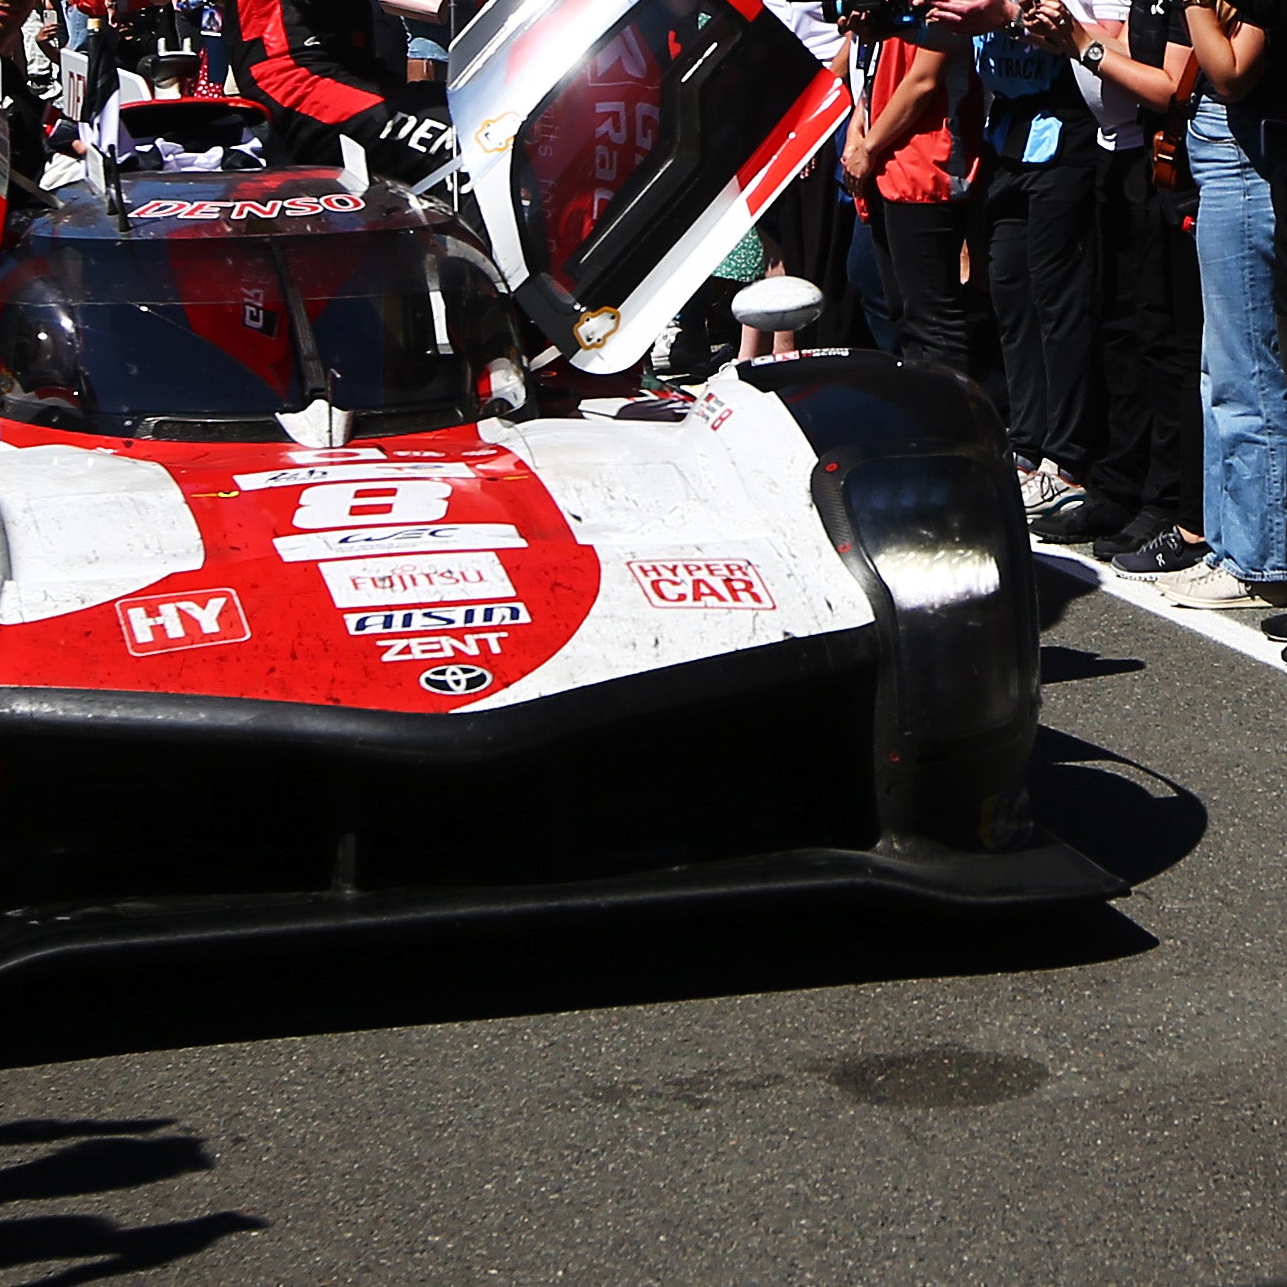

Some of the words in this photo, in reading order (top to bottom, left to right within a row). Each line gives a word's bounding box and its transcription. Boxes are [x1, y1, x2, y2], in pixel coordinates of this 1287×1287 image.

[127, 194, 366, 220] DENSO
[291, 480, 453, 529] 8
[338, 527, 460, 544] WEC
[351, 567, 485, 591] FUJITSU
[640, 561, 750, 579] HYPER
[650, 577, 764, 604] CAR
[126, 596, 229, 645] HY
[353, 605, 520, 632] AISIN
[375, 631, 509, 663] ZENT
